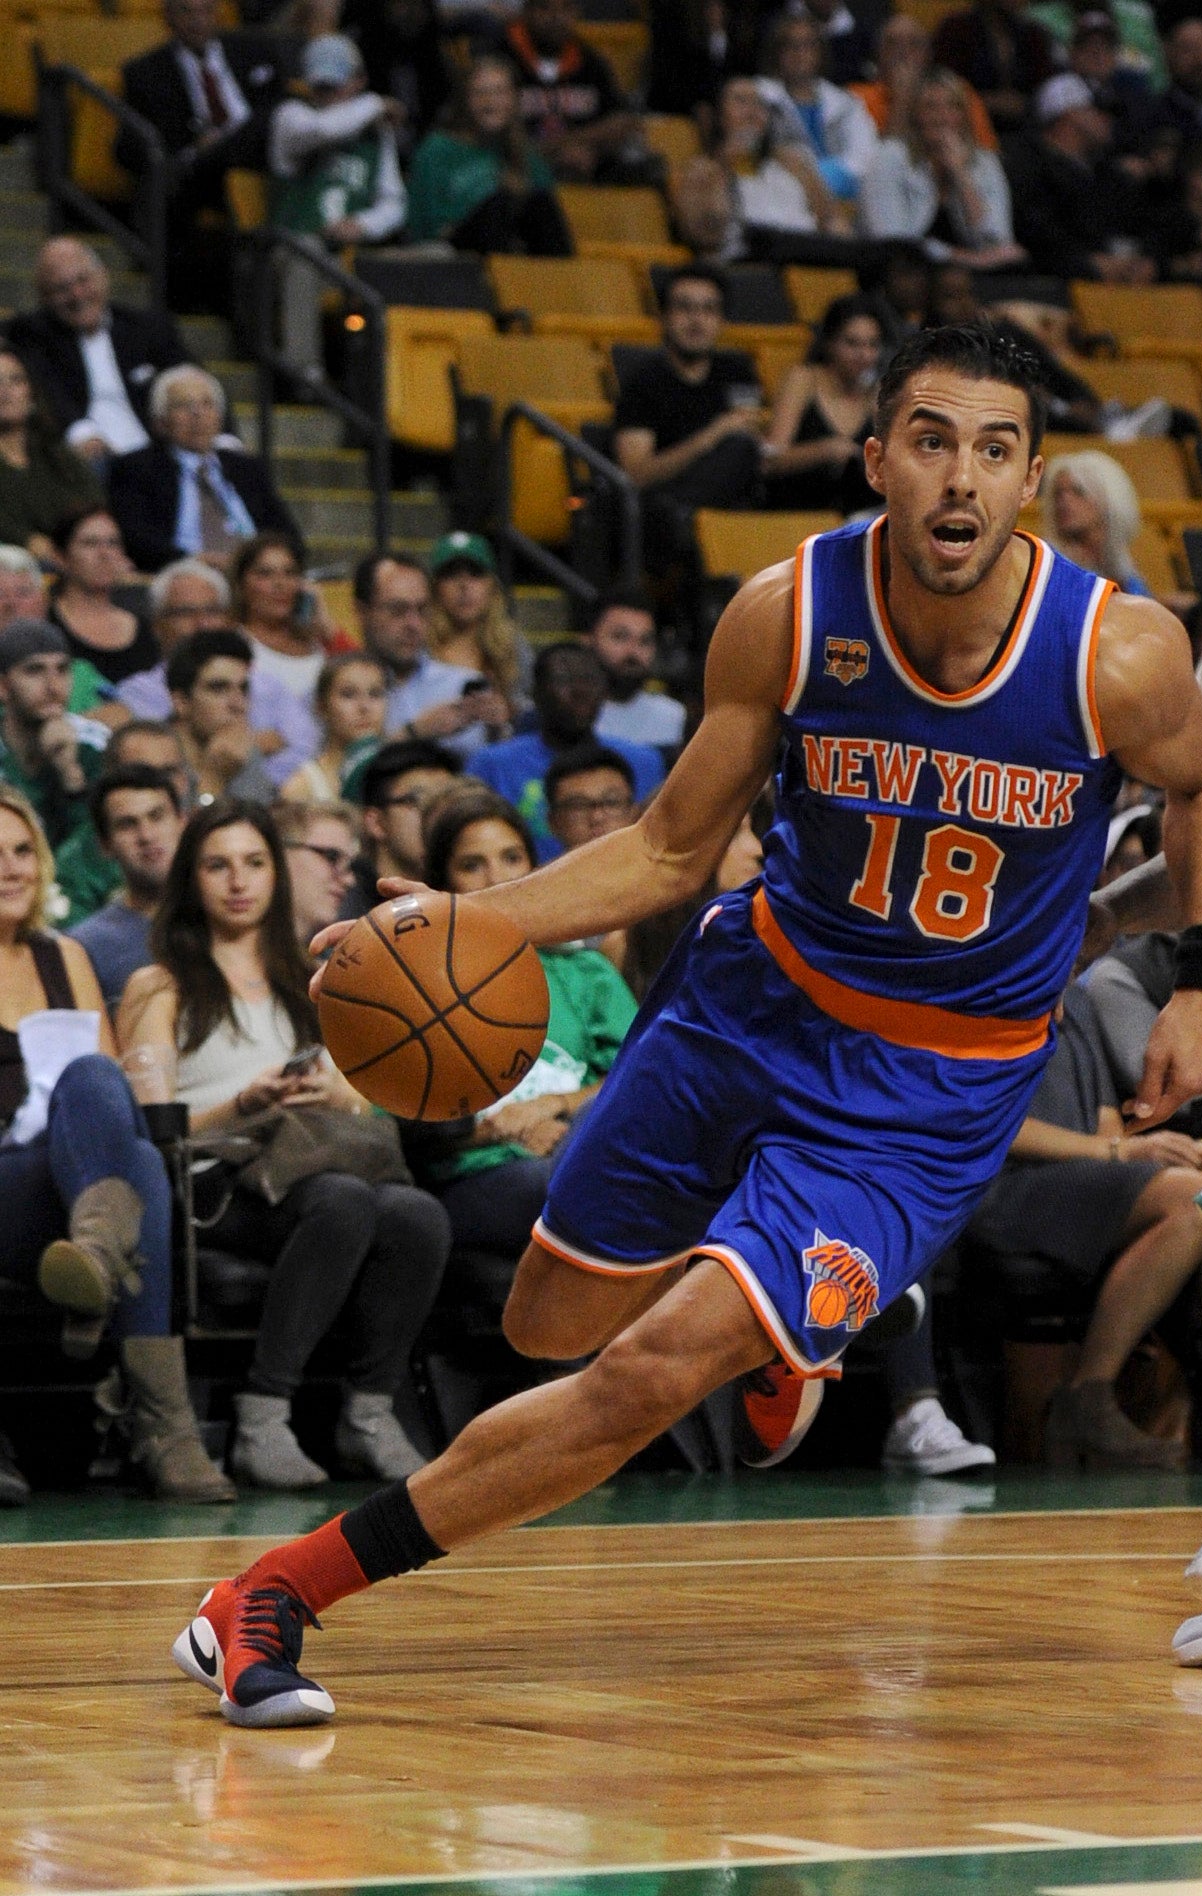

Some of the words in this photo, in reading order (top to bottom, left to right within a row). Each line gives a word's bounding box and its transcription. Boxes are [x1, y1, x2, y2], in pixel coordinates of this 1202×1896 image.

[802, 733, 927, 806] NEW
[931, 752, 1083, 829] YORK
[848, 813, 1005, 943] 18
[804, 1241, 878, 1328] KNICKS
